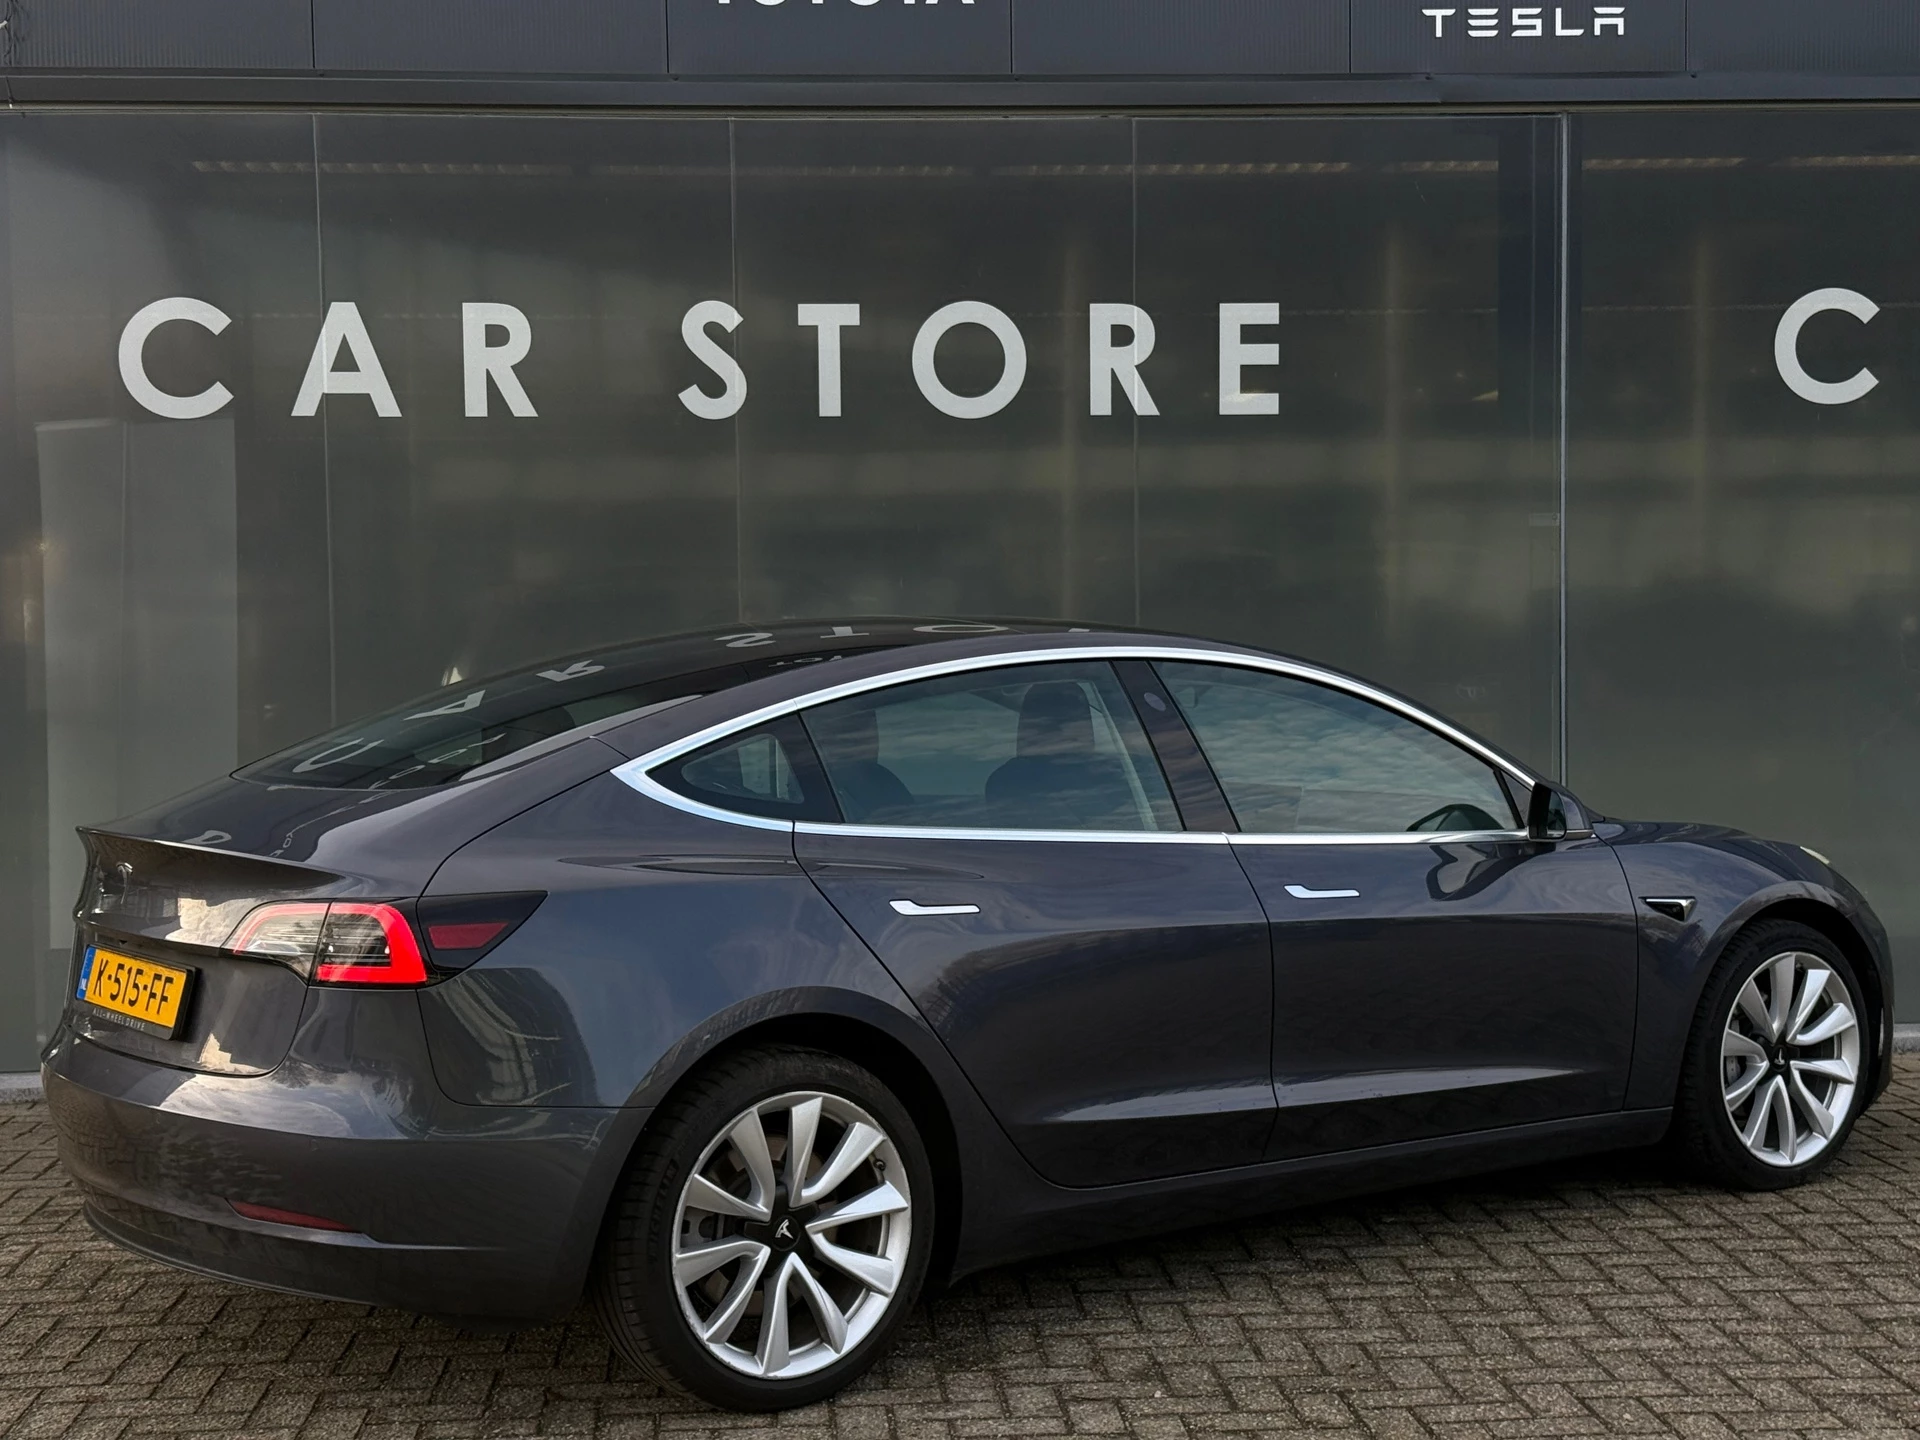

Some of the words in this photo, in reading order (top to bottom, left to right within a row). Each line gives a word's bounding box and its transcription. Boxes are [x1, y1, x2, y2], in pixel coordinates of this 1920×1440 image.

[1422, 7, 1625, 38] TESLA
[118, 297, 539, 420] CAR
[678, 300, 1280, 420] STORE
[93, 958, 175, 1015] K-515-FF
[125, 1016, 146, 1031] DRIVE
